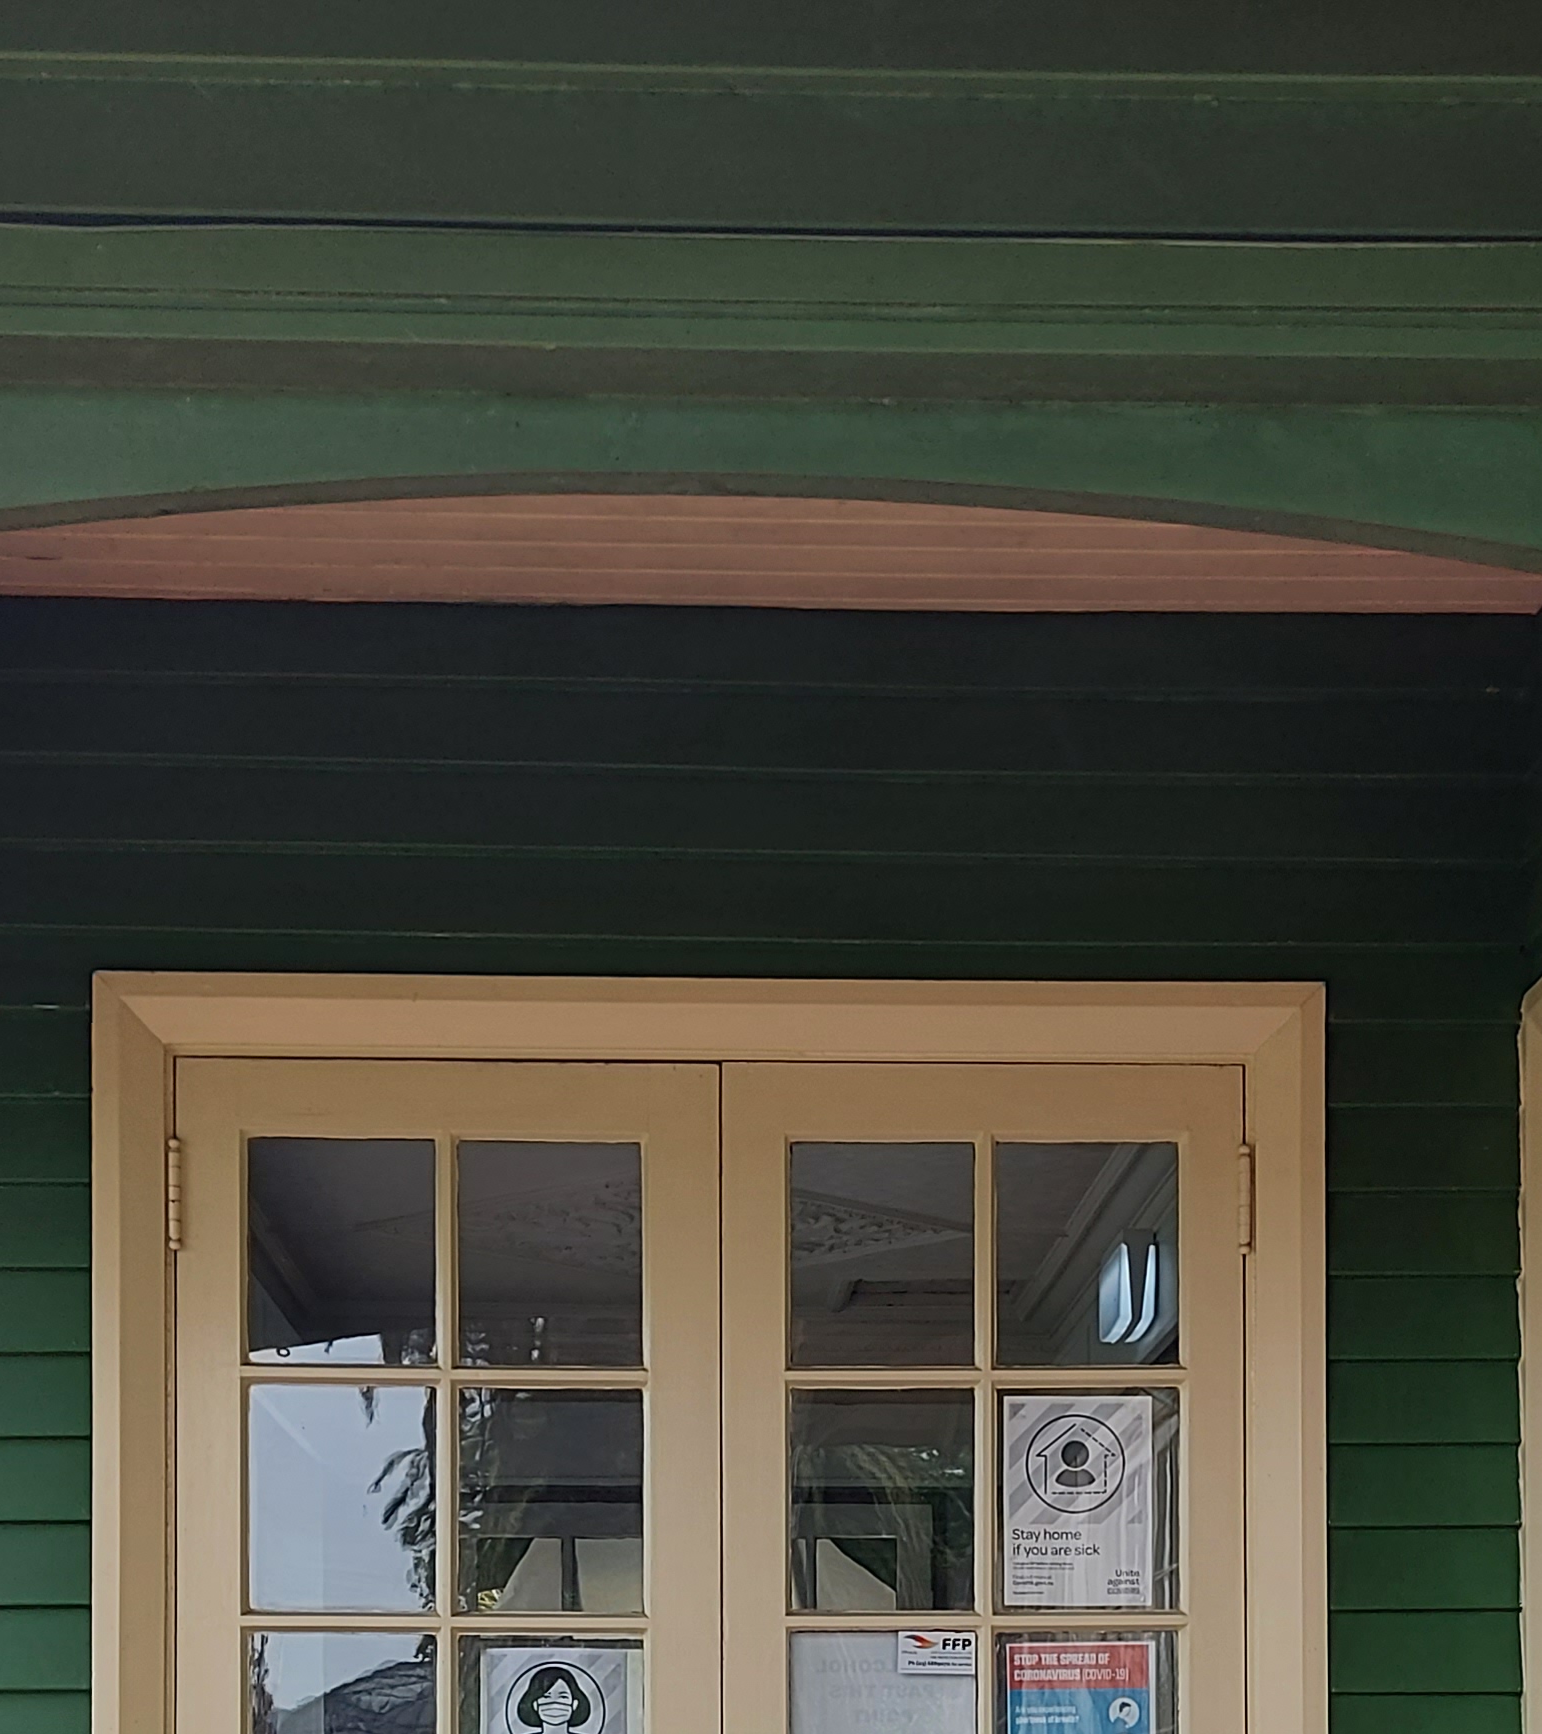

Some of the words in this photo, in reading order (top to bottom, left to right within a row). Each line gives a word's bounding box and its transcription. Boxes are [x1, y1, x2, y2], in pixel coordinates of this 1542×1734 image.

[1012, 1528, 1040, 1542] Stay
[1044, 1528, 1082, 1540] home
[1012, 1543, 1022, 1556] if
[1023, 1546, 1048, 1558] you
[1050, 1546, 1072, 1556] are
[1074, 1543, 1100, 1556] sick
[1107, 1578, 1140, 1587] against
[942, 1638, 972, 1651] FFP
[1013, 1654, 1039, 1665] STOP
[1040, 1653, 1058, 1665] THE
[1059, 1653, 1096, 1665] SPREAD
[1098, 1653, 1110, 1665] OF
[1014, 1669, 1081, 1681] CORONAVIRUS
[1082, 1668, 1129, 1681] (COVID-19)
